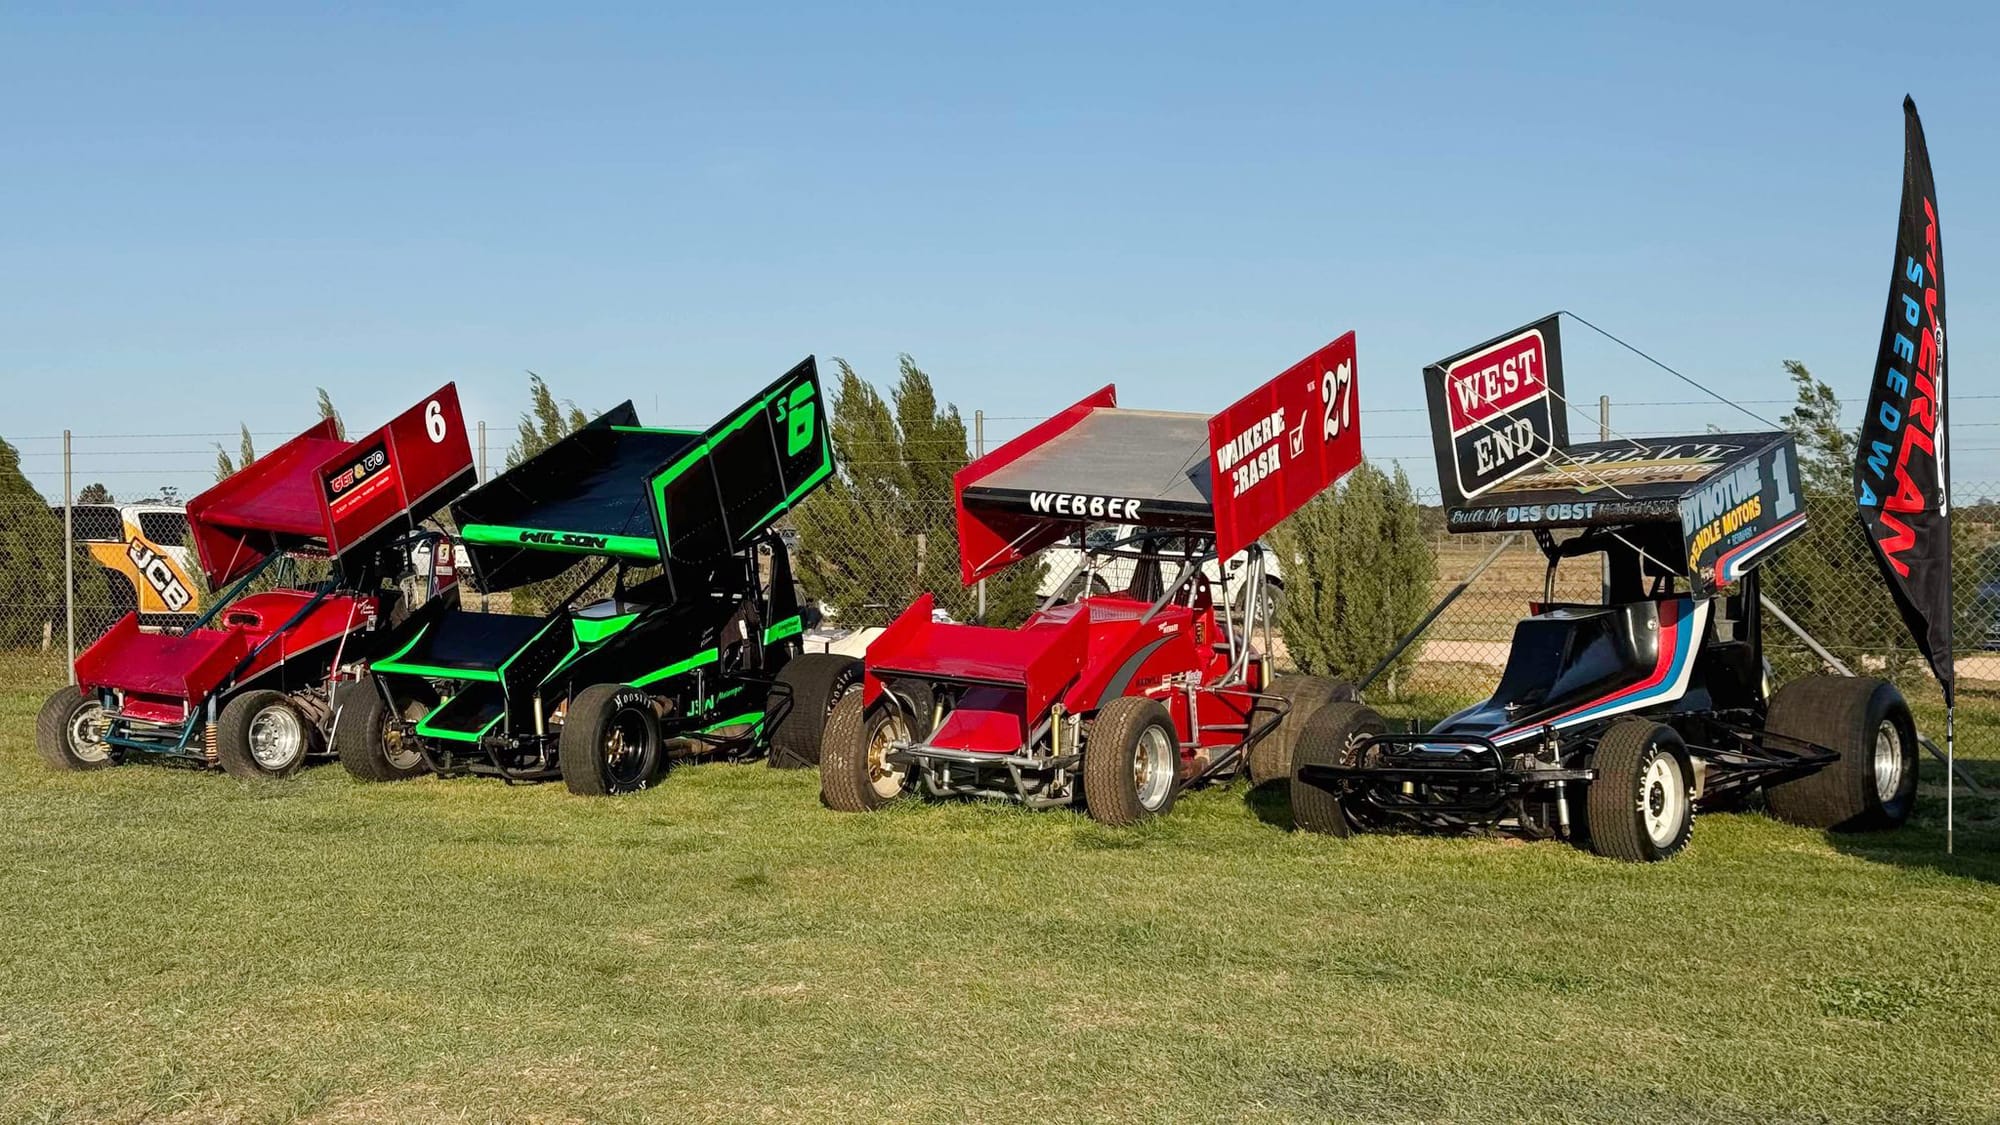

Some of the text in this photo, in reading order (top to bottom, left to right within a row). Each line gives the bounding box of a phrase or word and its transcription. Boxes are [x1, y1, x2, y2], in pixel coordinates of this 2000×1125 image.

[1321, 357, 1352, 442] 27
[1454, 347, 1537, 413] WEST
[1859, 255, 1924, 508] SPEEDWA
[425, 400, 447, 443] 6
[1473, 417, 1535, 477] END
[330, 467, 355, 493] GET
[363, 450, 385, 472] GO
[1771, 446, 1797, 520] 1
[1029, 491, 1142, 520] WEBBER
[1452, 508, 1485, 525] Built
[1485, 507, 1504, 529] by
[1506, 505, 1542, 524] DES
[1545, 502, 1599, 521] OBST
[1689, 495, 1762, 574] PENDLE MOTORS
[519, 530, 609, 549] WILSON
[128, 545, 190, 612] JCB
